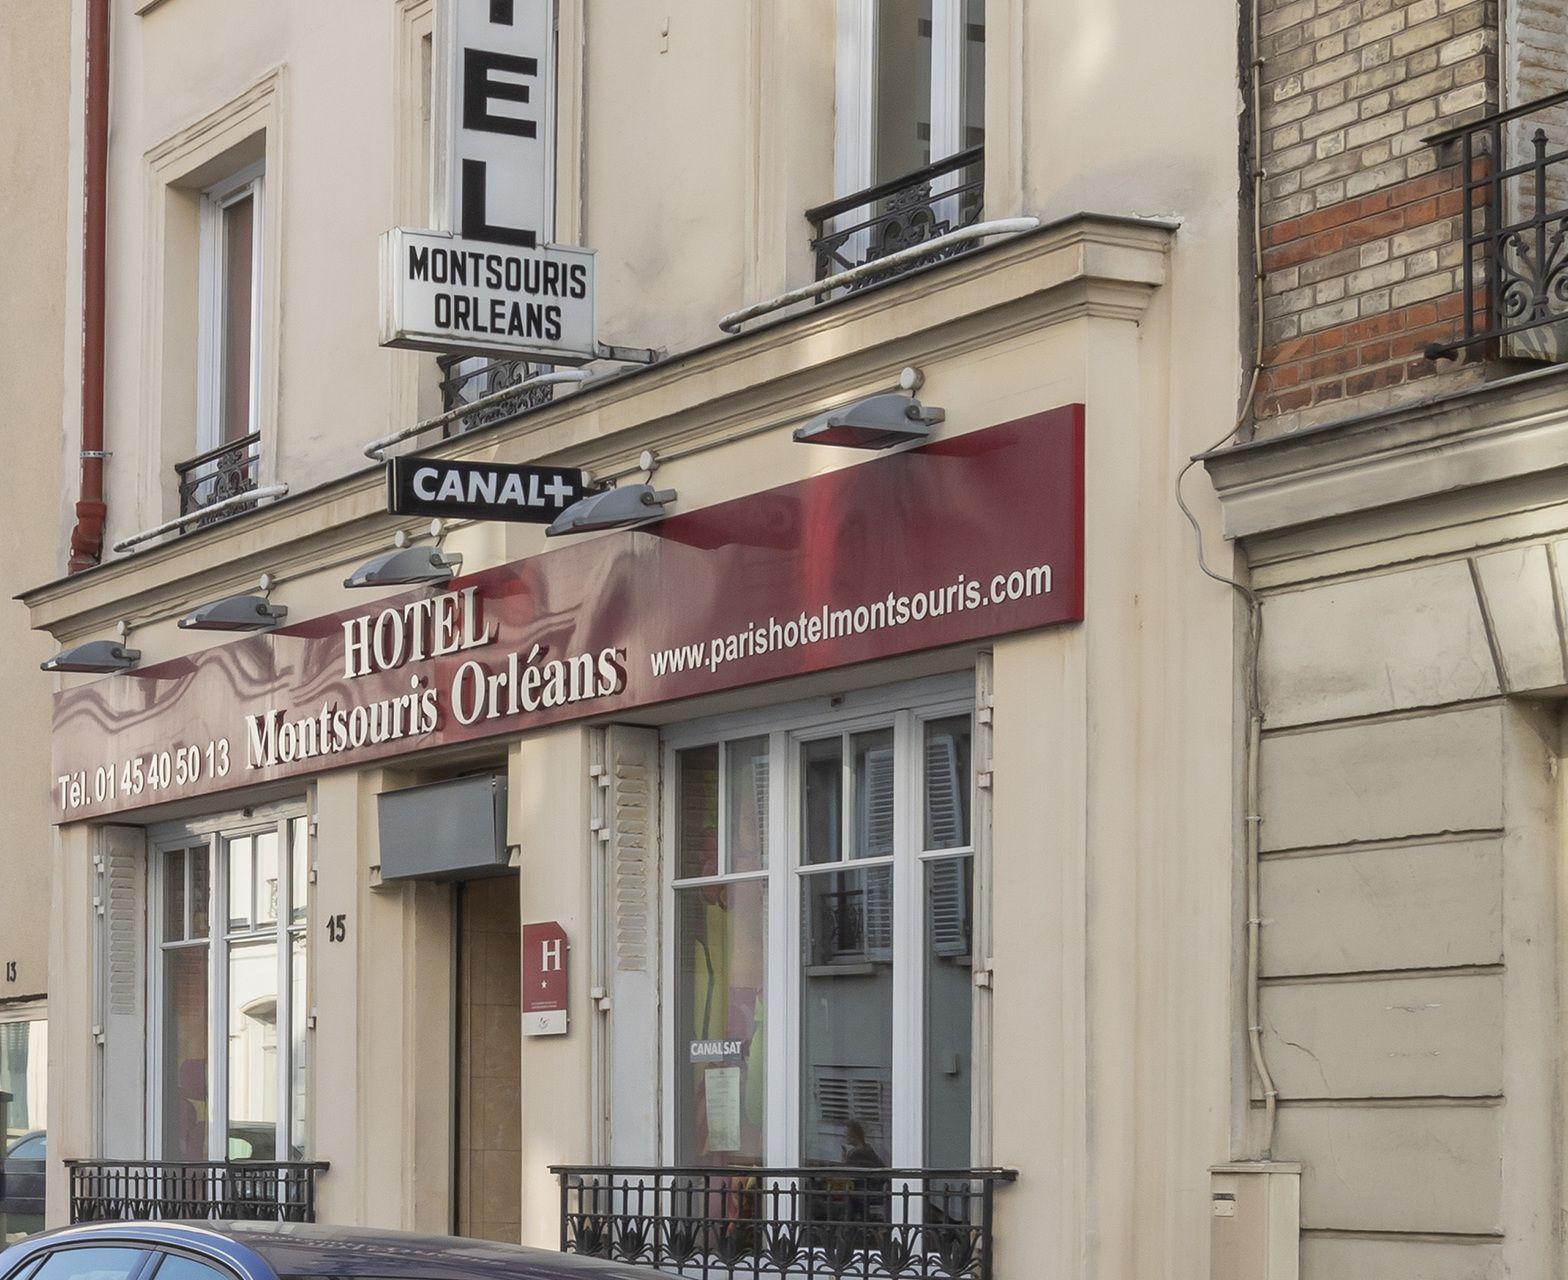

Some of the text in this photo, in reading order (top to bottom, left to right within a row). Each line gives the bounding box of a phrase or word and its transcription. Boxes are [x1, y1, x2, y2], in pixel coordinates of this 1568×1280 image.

[409, 245, 587, 299] MONTSOURIS
[435, 293, 562, 341] ORLEANS
[412, 467, 575, 508] CANAL+
[342, 586, 492, 680] HOTEL
[650, 563, 1053, 678] www.parishotelmontsouris.com
[244, 643, 621, 772] Montsouris Orléans
[58, 738, 231, 810] Tél. 01 45 40 50 13
[326, 914, 347, 942] 15
[6, 961, 17, 982] 13
[540, 938, 563, 972] H
